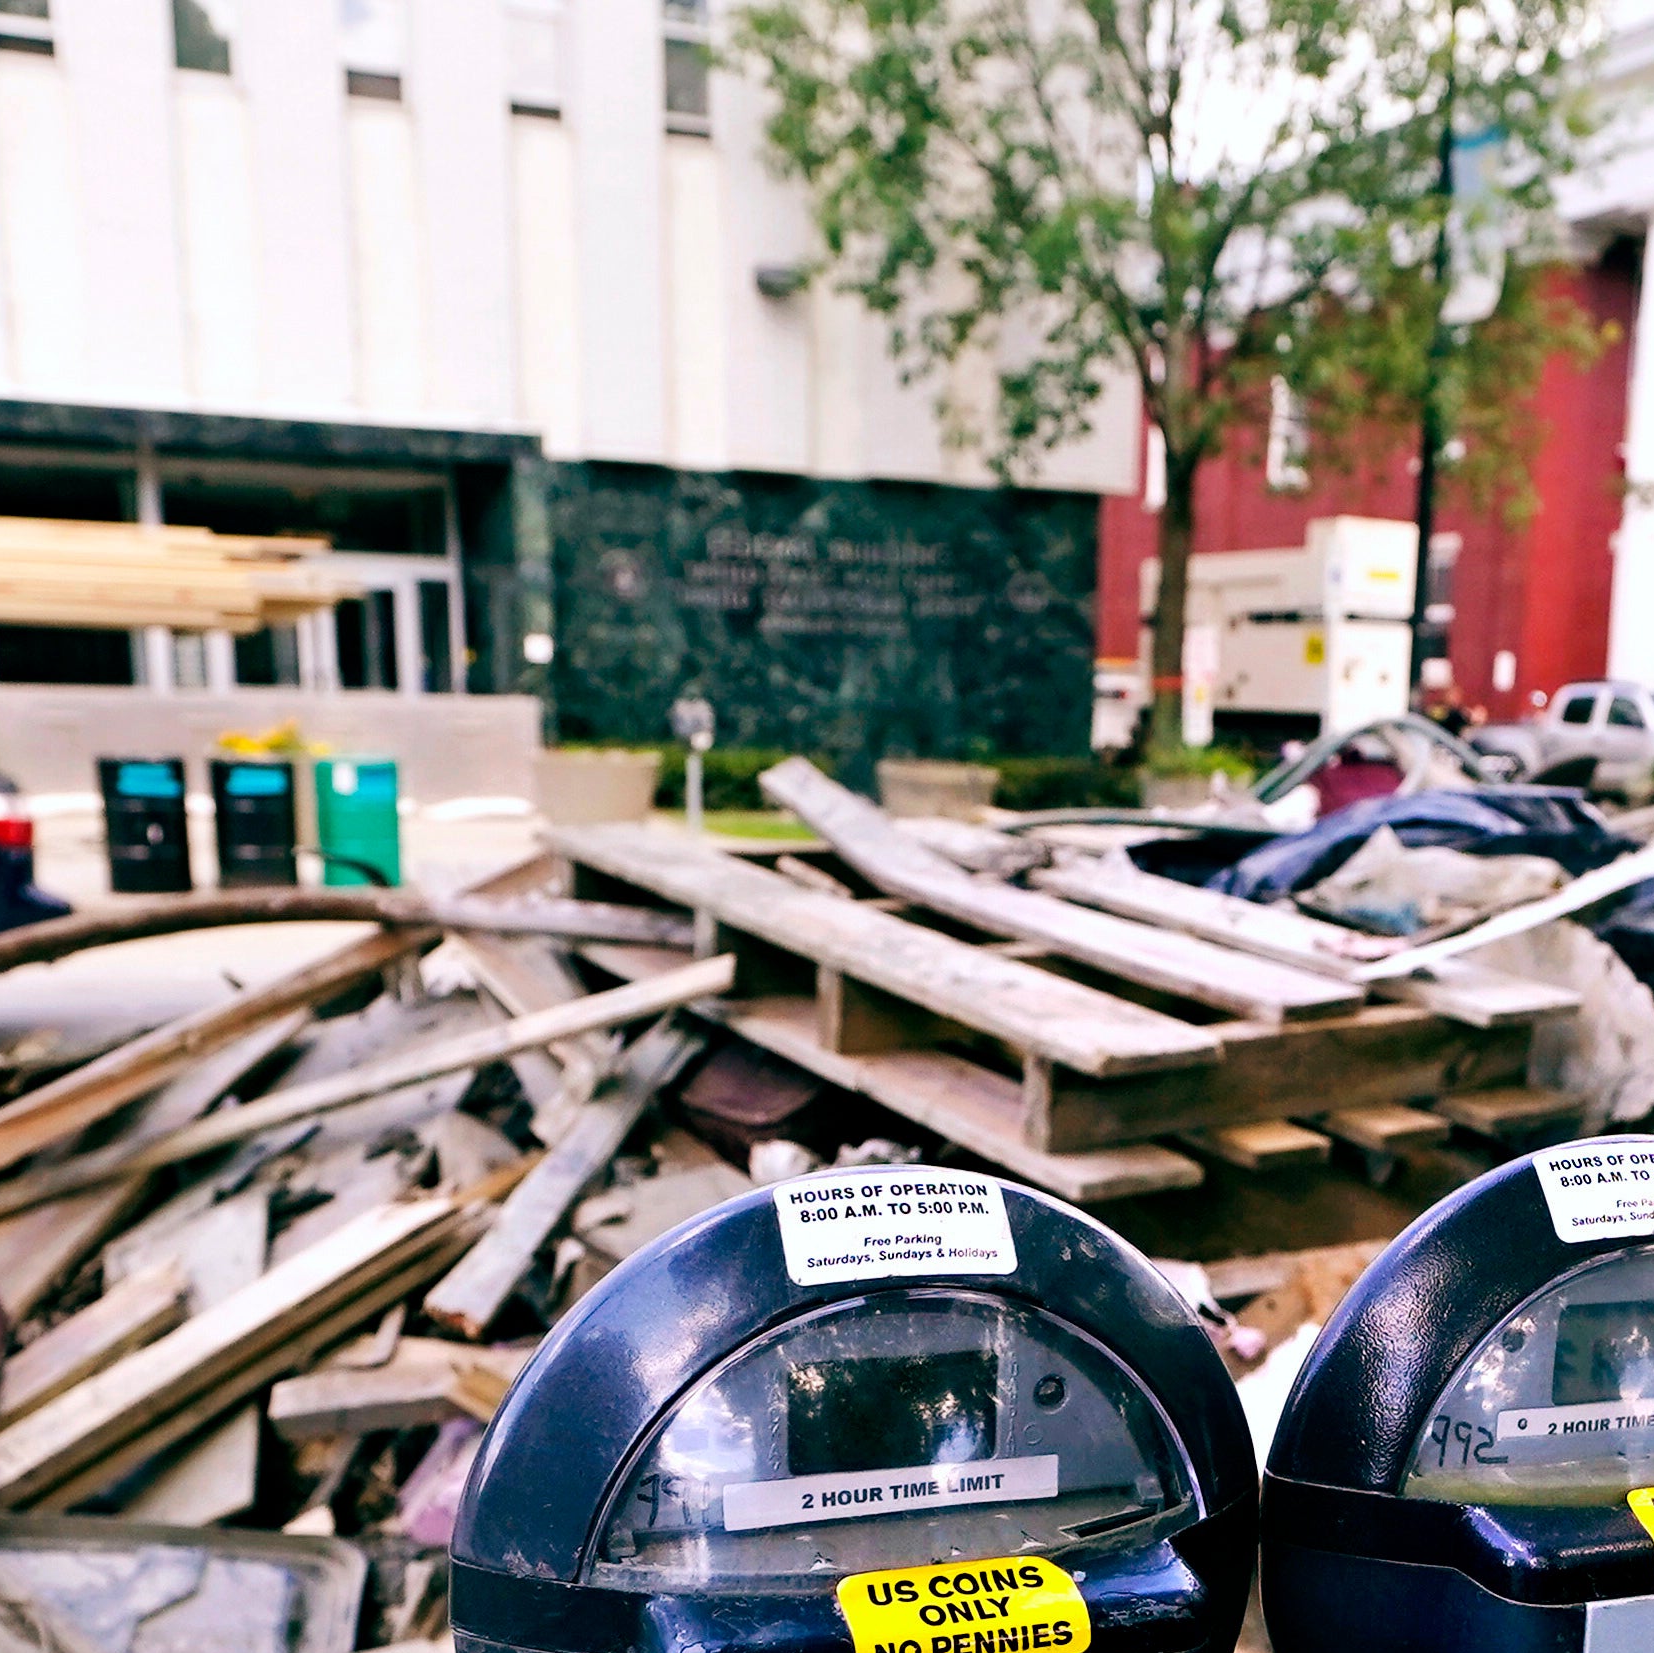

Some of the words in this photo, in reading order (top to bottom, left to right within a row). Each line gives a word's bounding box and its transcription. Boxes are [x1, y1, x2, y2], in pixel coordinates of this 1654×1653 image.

[1549, 1155, 1603, 1171] HOURS
[1607, 1154, 1626, 1166] OF
[1560, 1174, 1592, 1187] 8:00
[1597, 1171, 1628, 1184] A.M.
[1631, 1170, 1650, 1181] TO
[790, 1187, 855, 1204] HOURS
[861, 1185, 883, 1198] OF
[890, 1183, 987, 1196] OPERATION
[800, 1207, 838, 1223] 8:00
[845, 1205, 882, 1218] A.M.
[888, 1203, 912, 1215] TO
[918, 1201, 953, 1214] 5:00
[959, 1202, 989, 1215] P.M.
[1616, 1199, 1638, 1208] Free
[1571, 1213, 1627, 1227] Saturdays,
[864, 1236, 891, 1247] Free
[895, 1234, 942, 1246] Parking
[807, 1253, 874, 1268] Saturdays,
[879, 1249, 932, 1261] Sundays
[936, 1248, 945, 1257] &
[948, 1248, 998, 1259] Holidays
[1548, 1423, 1558, 1436] 2
[1563, 1419, 1611, 1434] HOUR
[801, 1493, 815, 1509] 2
[821, 1488, 883, 1508] HOUR
[889, 1481, 940, 1500] TIME
[946, 1473, 1005, 1493] LIMIT
[867, 1580, 919, 1606] US
[928, 1566, 1044, 1598] COINS
[919, 1596, 1010, 1626] ONLY
